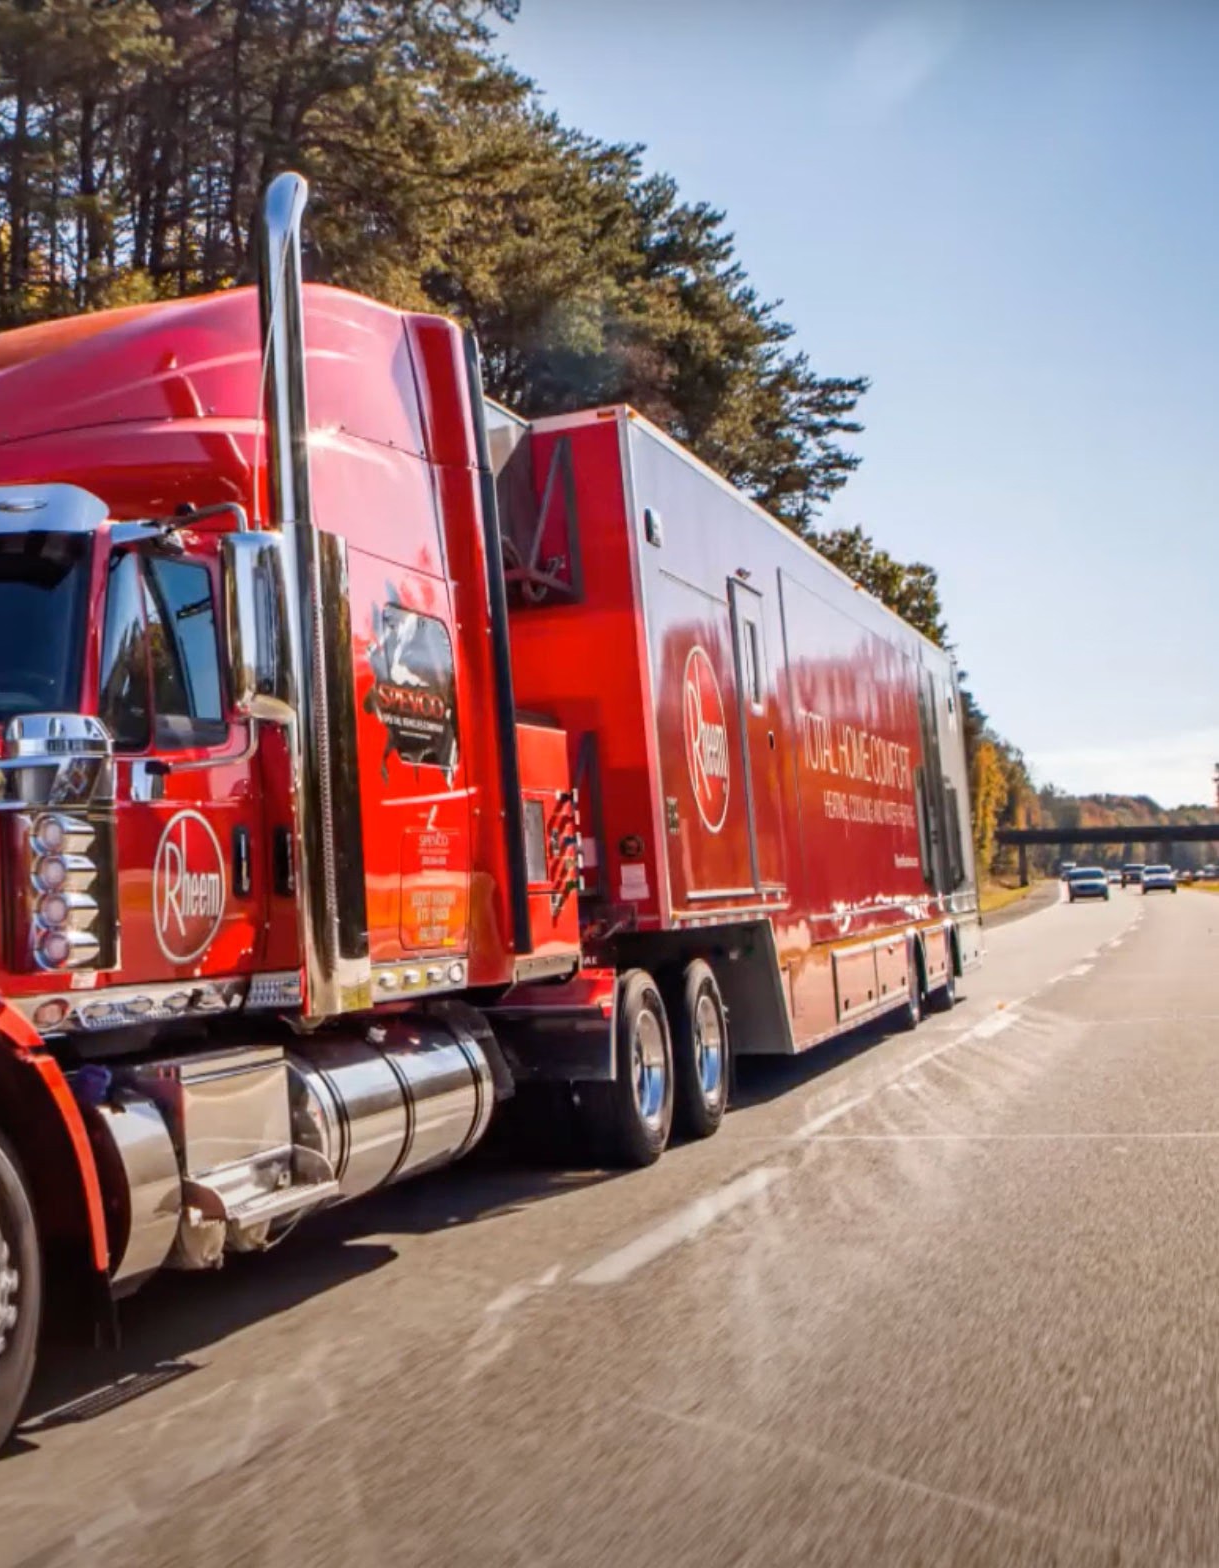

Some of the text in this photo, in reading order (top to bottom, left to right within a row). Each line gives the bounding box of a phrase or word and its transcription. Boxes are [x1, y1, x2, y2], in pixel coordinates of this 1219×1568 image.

[378, 685, 445, 719] SPEVCO
[688, 655, 728, 800] Rheem
[798, 708, 912, 791] TOTAL HOME COMFORT
[162, 818, 220, 937] Rheem
